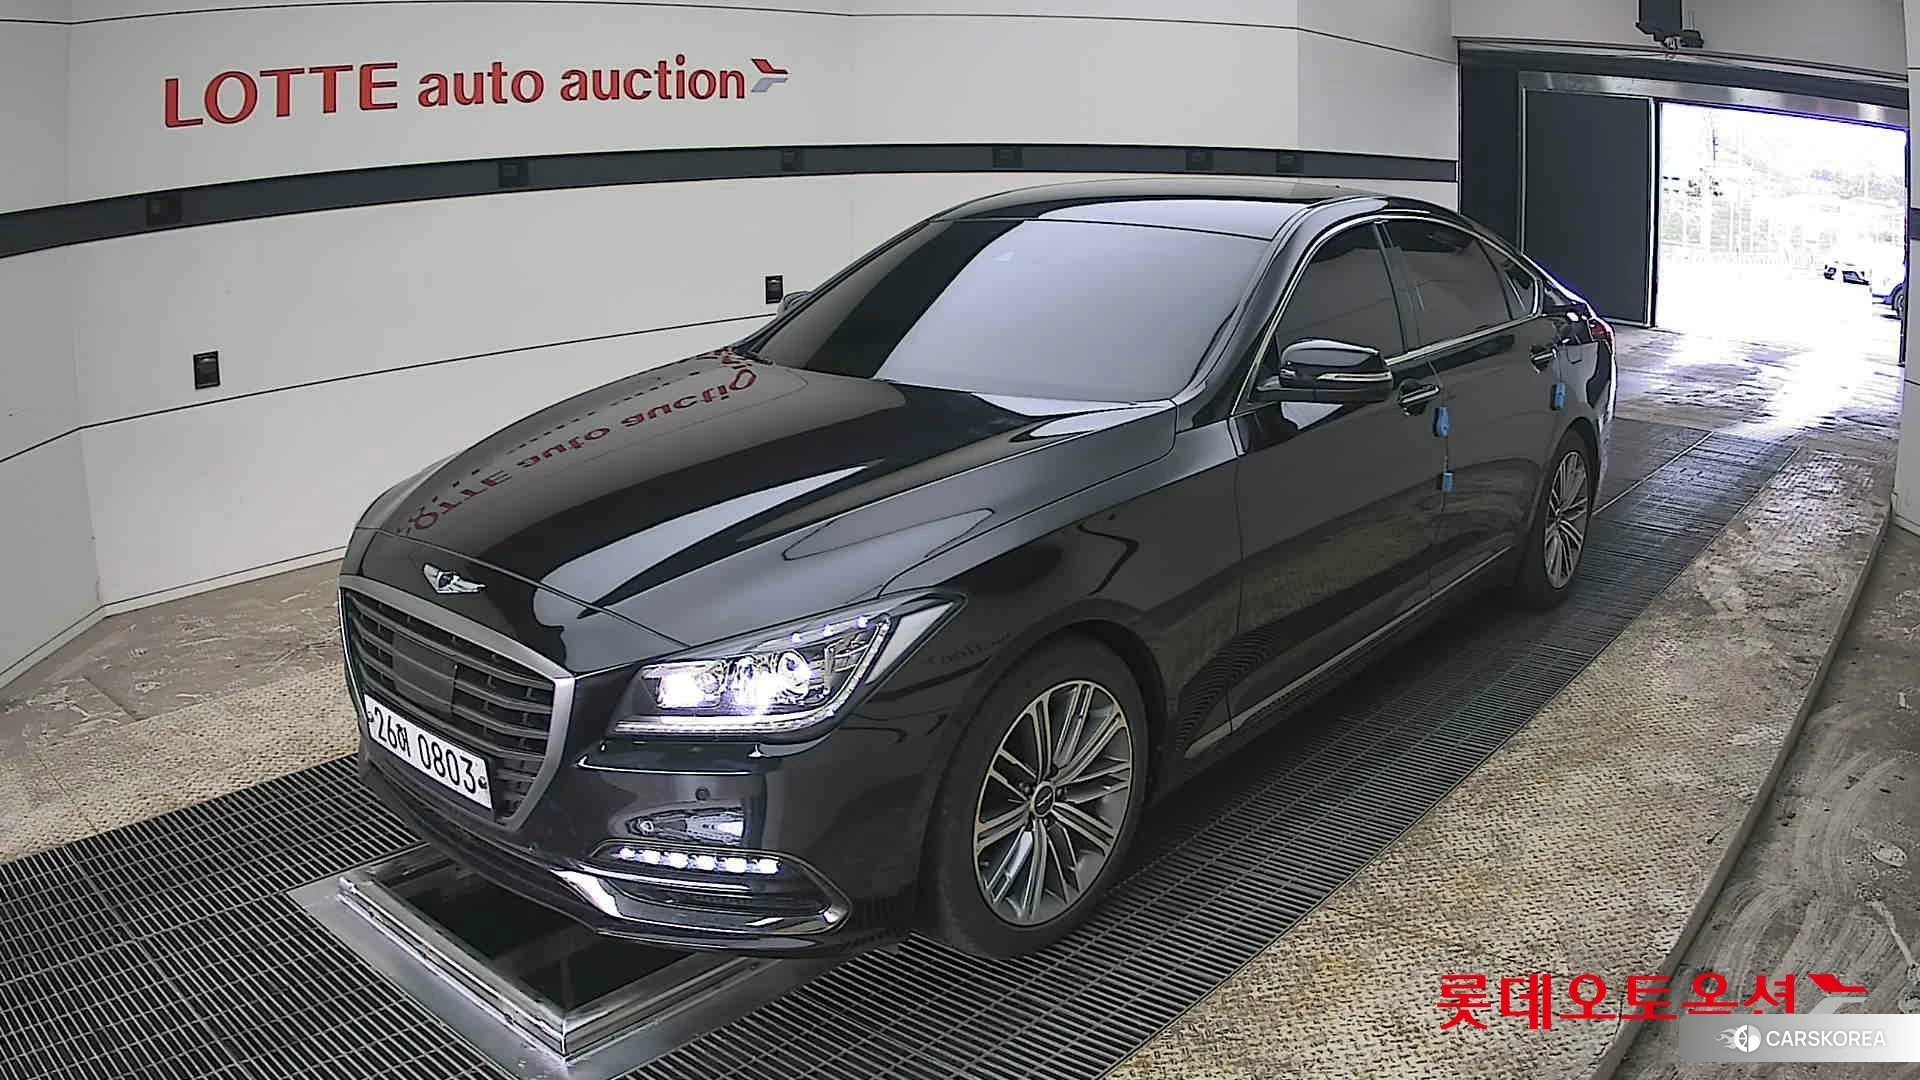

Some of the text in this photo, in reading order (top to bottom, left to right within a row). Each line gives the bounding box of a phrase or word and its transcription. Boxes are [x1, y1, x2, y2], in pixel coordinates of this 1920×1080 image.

[164, 54, 747, 128] LOTTE auto auction
[417, 733, 477, 794] 0803
